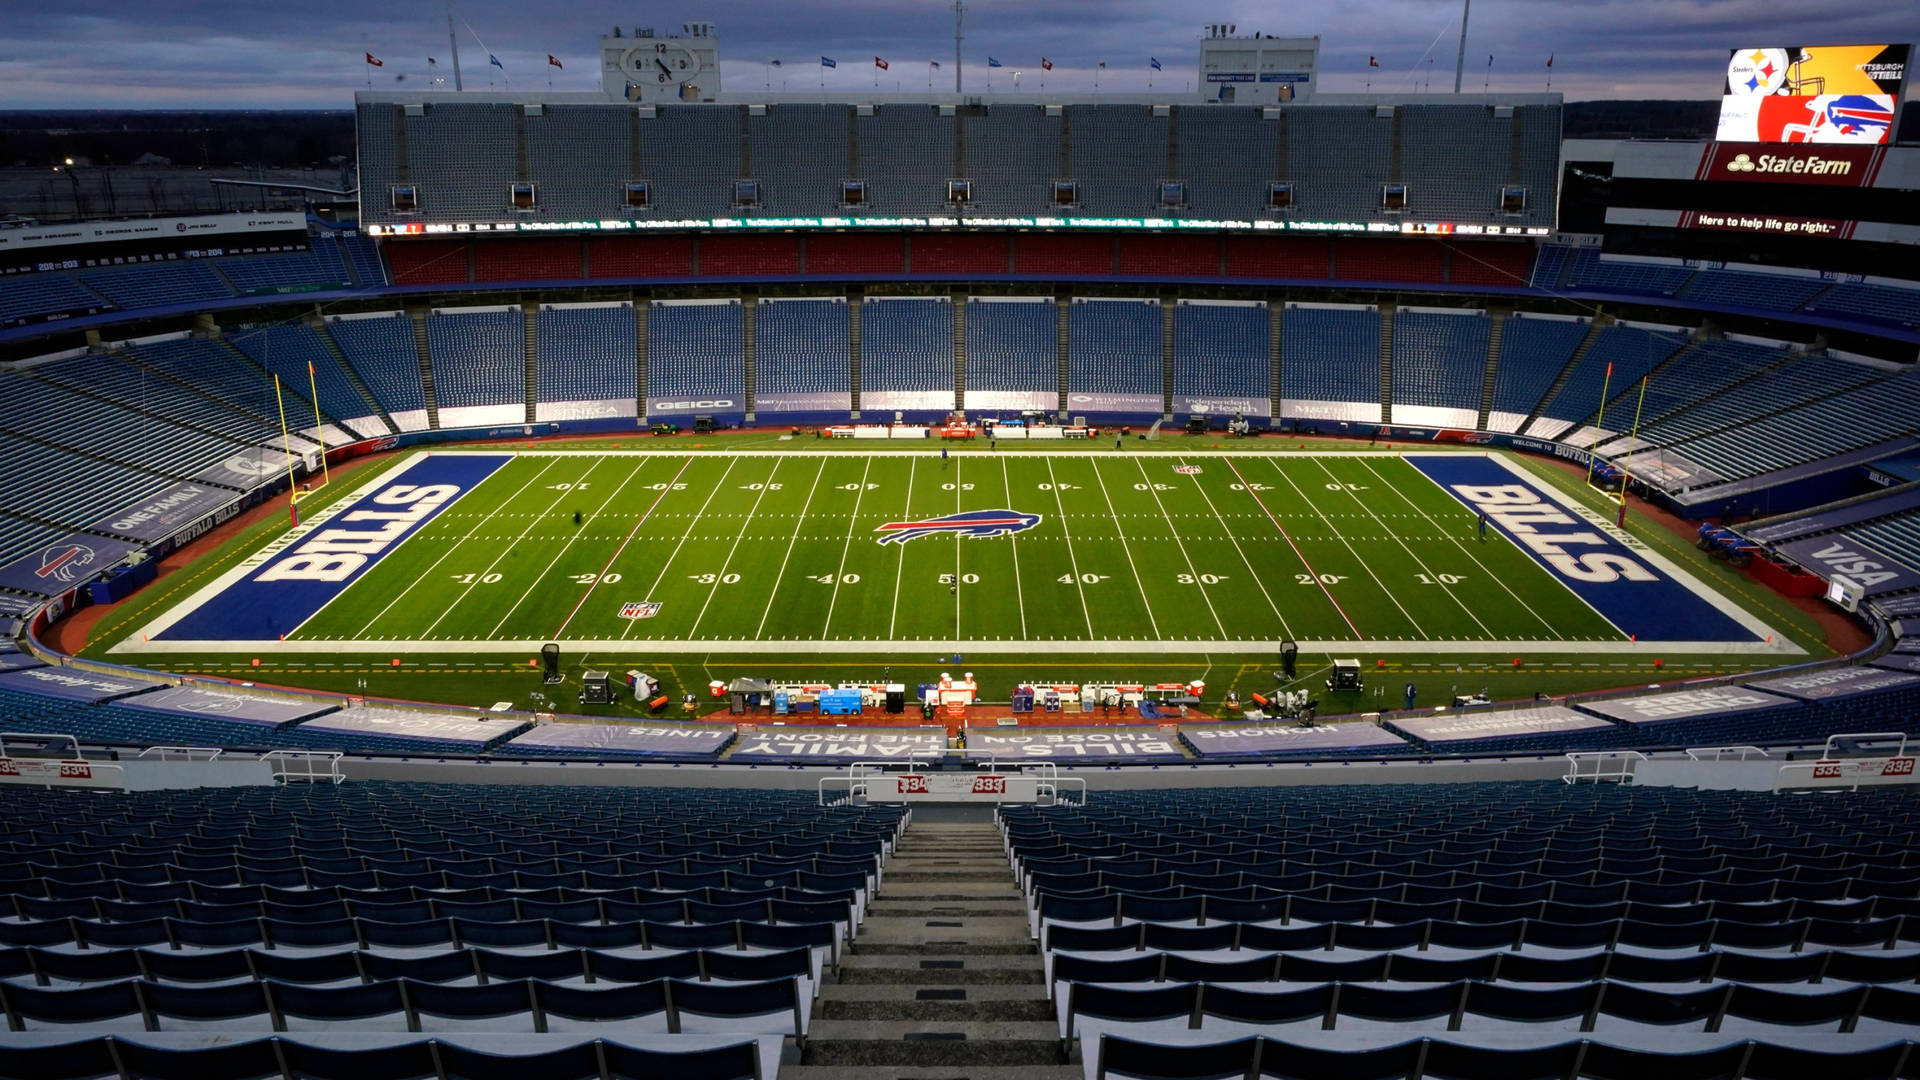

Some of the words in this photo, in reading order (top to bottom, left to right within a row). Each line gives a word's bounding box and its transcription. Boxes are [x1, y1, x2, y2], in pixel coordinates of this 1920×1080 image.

[654, 44, 666, 53] 12
[635, 60, 642, 69] 9
[680, 60, 686, 69] 3
[658, 74, 664, 82] 6
[1699, 215, 1724, 226] Here
[1727, 217, 1739, 227] to
[1740, 217, 1763, 231] help
[1765, 219, 1782, 230] life
[1784, 222, 1799, 233] go
[38, 262, 54, 271] 202
[656, 400, 734, 410] GEICO
[1095, 396, 1160, 404] WILMINGTON
[1185, 398, 1250, 407] Independent
[1210, 404, 1258, 414] Health
[1512, 440, 1542, 449] WELCOME
[1869, 472, 1890, 486] BILLS
[112, 509, 154, 530] ONE
[152, 486, 205, 515] FAMILY
[174, 518, 213, 548] BUFFALO
[215, 504, 240, 525] BILLS
[1571, 507, 1601, 520] END
[1594, 522, 1648, 550] RACISM
[252, 484, 461, 582] BILLS
[260, 530, 306, 554] TAKES
[302, 515, 332, 526] ALL
[1450, 484, 1660, 583] BILLS
[1811, 542, 1900, 586] VISA
[458, 574, 503, 584] 10
[576, 574, 622, 584] 20
[698, 574, 741, 584] 30
[817, 574, 861, 584] 40
[938, 574, 980, 584] 50
[1057, 574, 1100, 584] 40
[1177, 574, 1219, 584] 30
[1294, 574, 1338, 584] 20
[1414, 574, 1458, 584] 10
[628, 728, 722, 738] LINES
[1196, 725, 1338, 738] HONORS
[752, 734, 867, 742] FRONT
[880, 734, 944, 743] THE
[1045, 733, 1158, 742] THOSE
[741, 742, 940, 756] FAMILY
[1022, 742, 1174, 755] BILLS
[0, 760, 17, 772] 35
[61, 763, 89, 776] 334
[1815, 764, 1842, 776] 333
[1884, 760, 1913, 773] 332
[900, 778, 928, 791] 334
[974, 778, 1004, 791] 333
